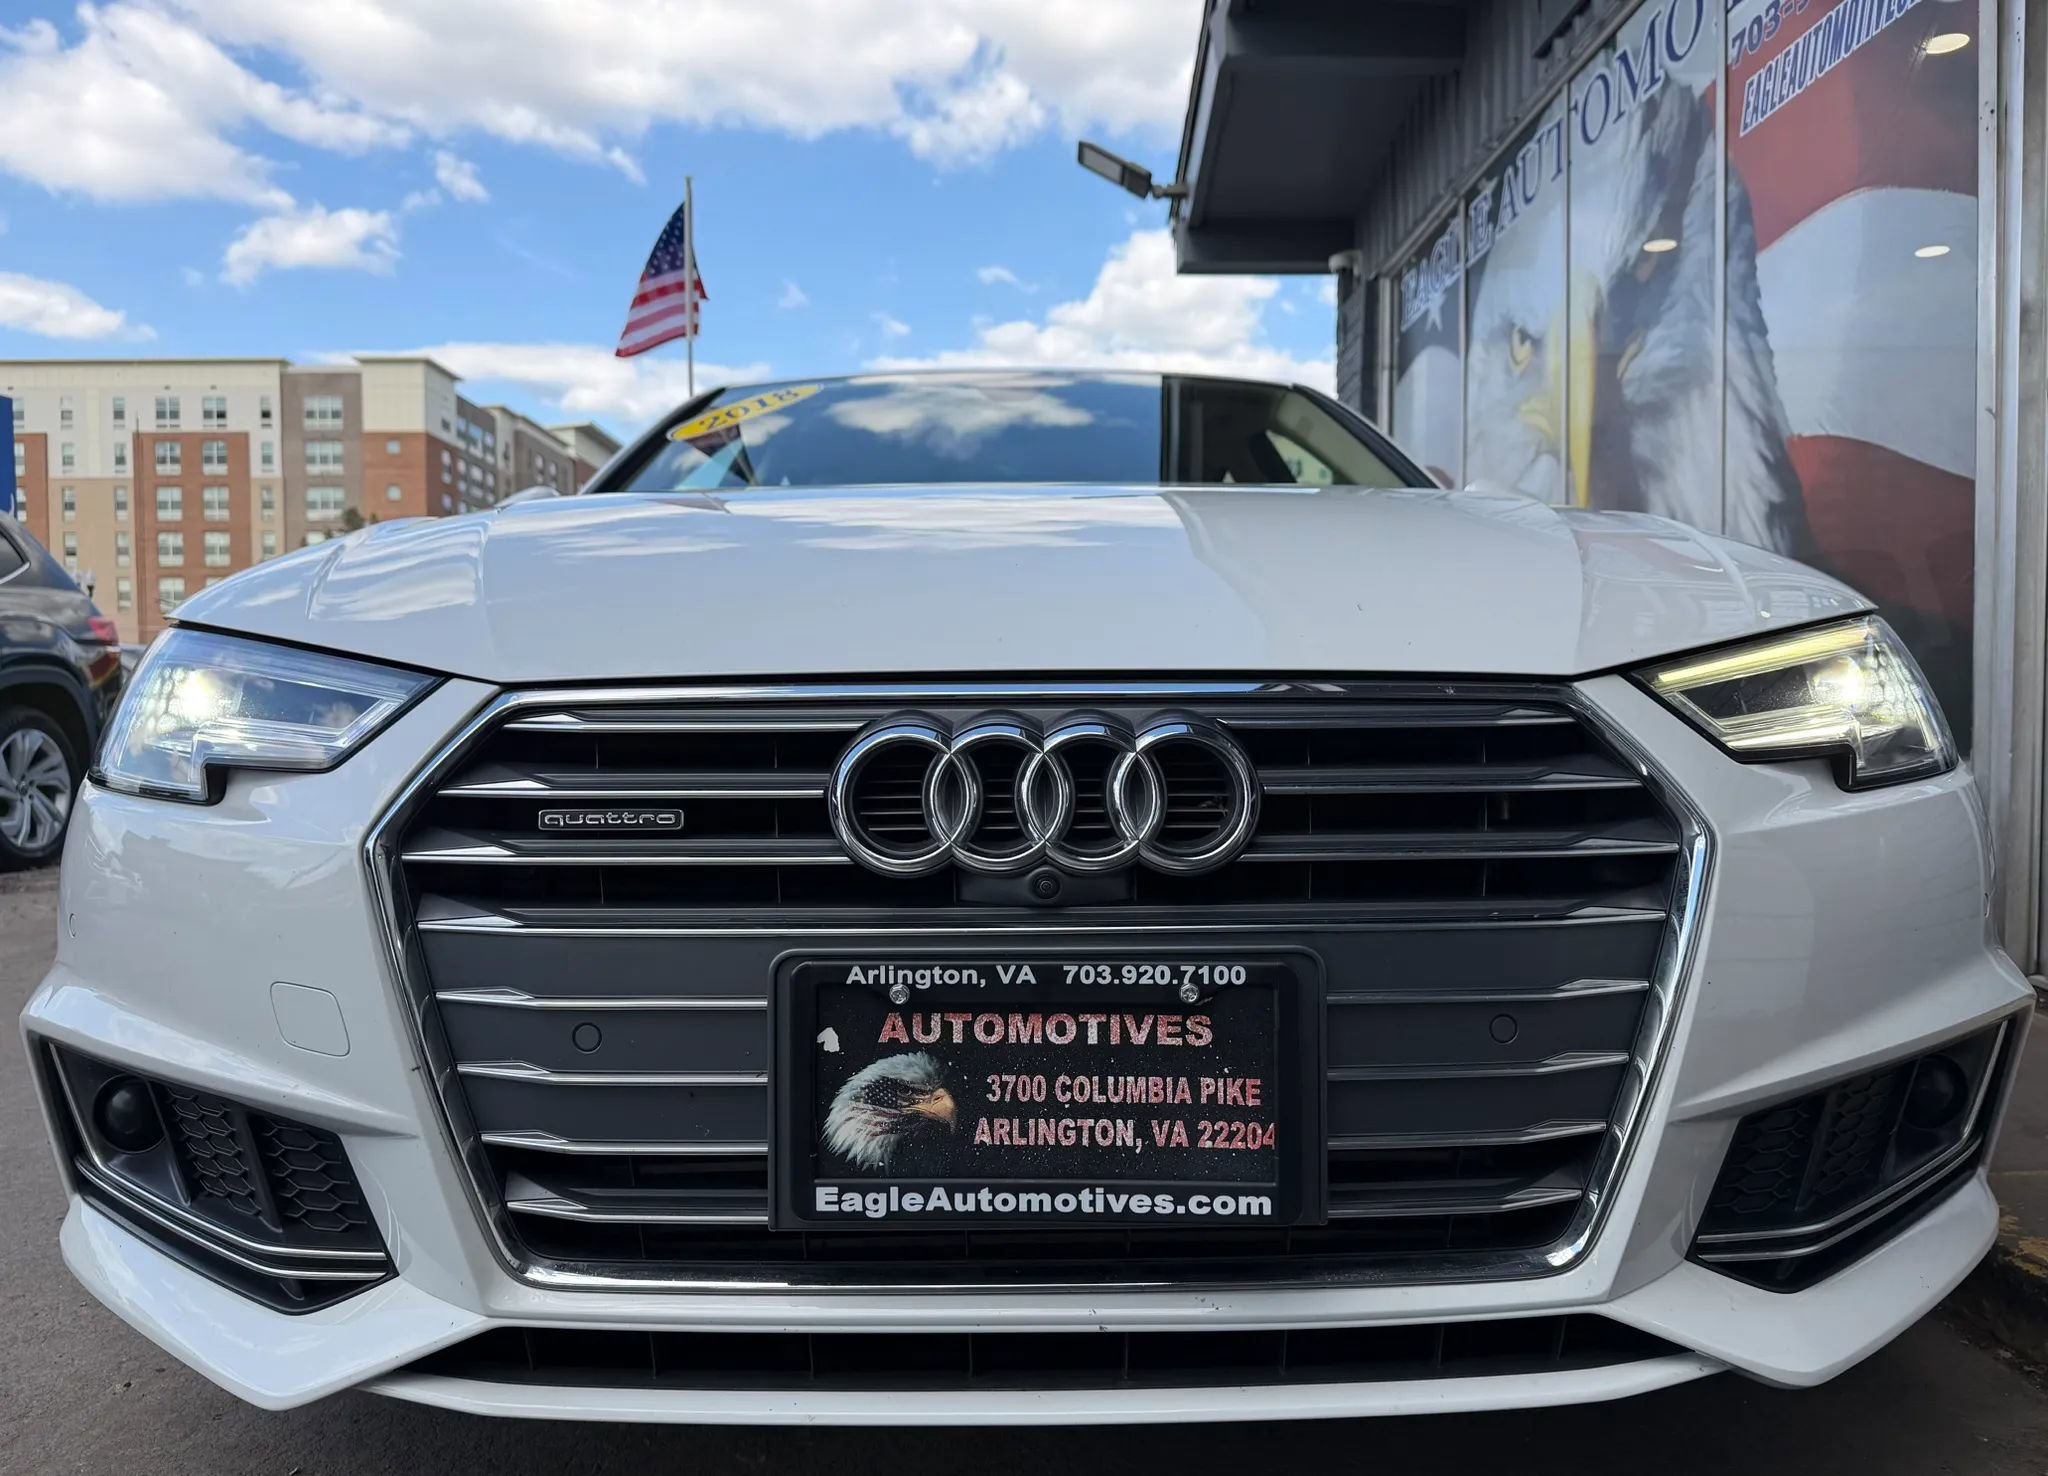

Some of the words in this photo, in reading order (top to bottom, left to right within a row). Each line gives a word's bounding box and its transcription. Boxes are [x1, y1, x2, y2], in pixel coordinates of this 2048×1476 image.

[544, 811, 676, 827] quattro
[846, 965, 986, 989] Arlington,
[996, 965, 1037, 985] VA
[1063, 965, 1247, 985] 703.920.7100
[878, 1012, 1214, 1047] AUTOMOTIVES
[986, 1074, 1046, 1102] 3700
[1055, 1074, 1192, 1104] COLUMBIA
[1200, 1077, 1262, 1106] PIKE
[973, 1117, 1142, 1153] ARLINGTON,
[1151, 1120, 1189, 1148] VA
[1198, 1120, 1276, 1150] 22204
[815, 1186, 1272, 1218] EagleAutomotives.com
